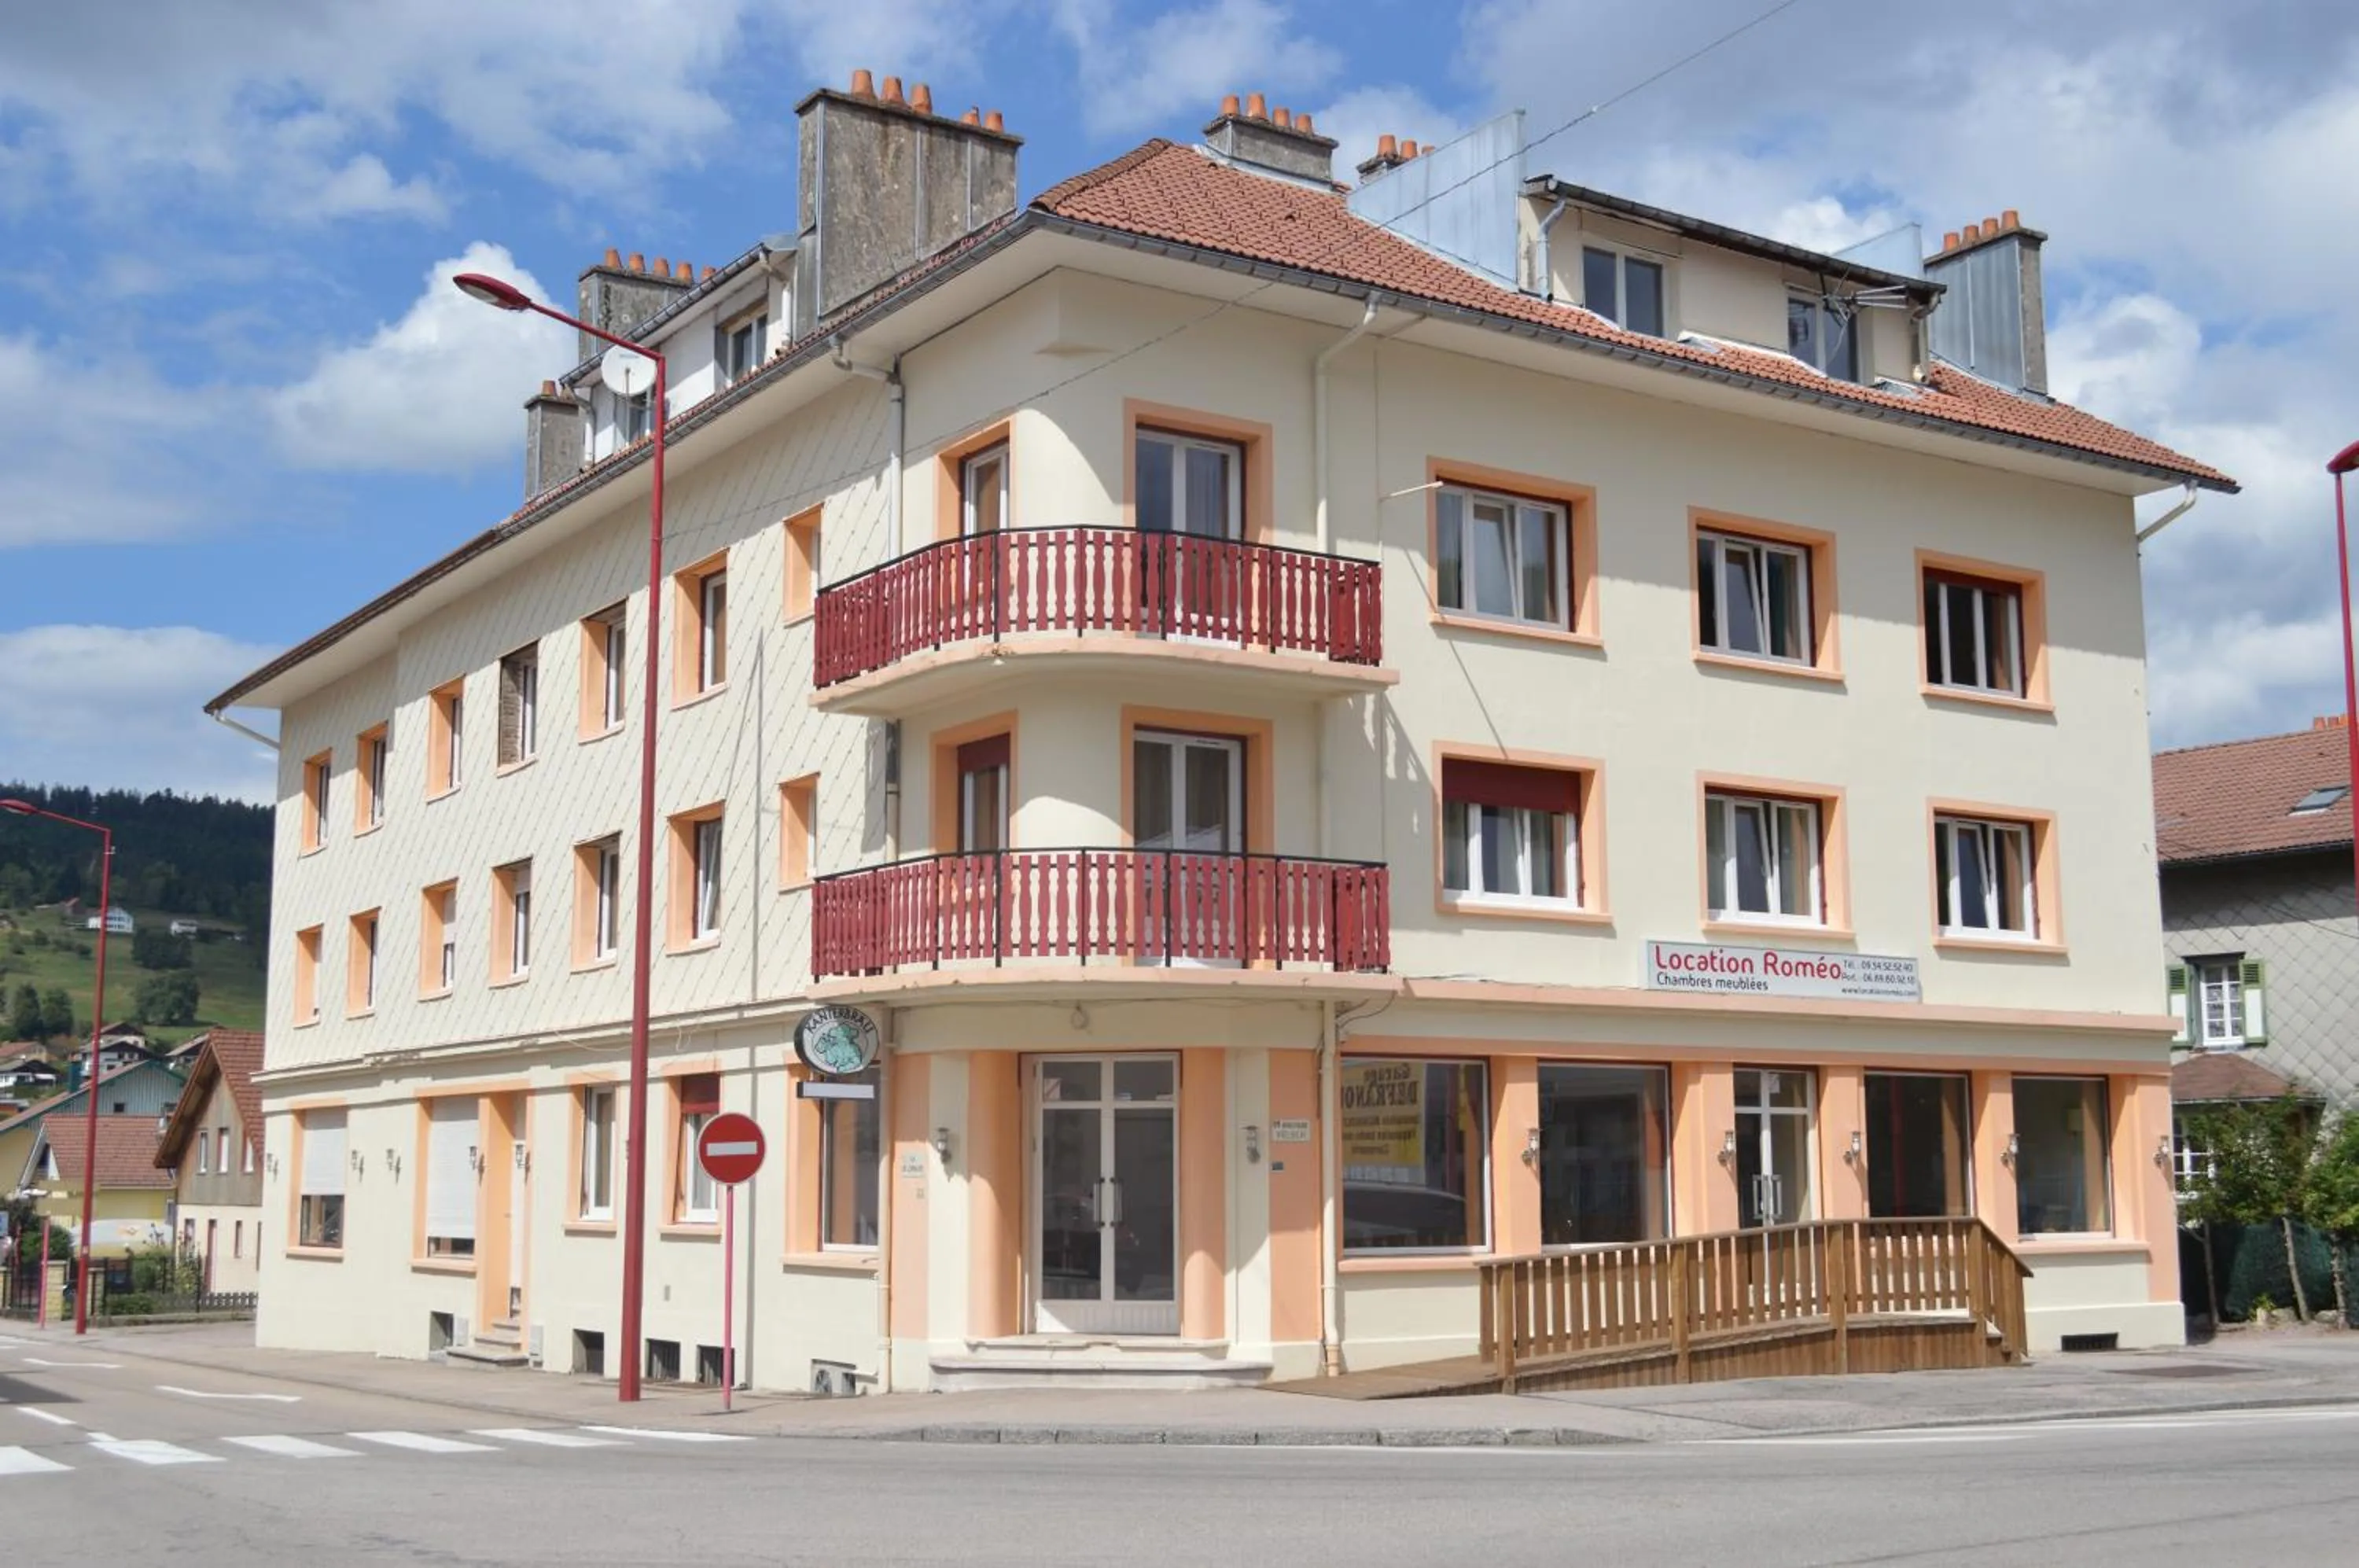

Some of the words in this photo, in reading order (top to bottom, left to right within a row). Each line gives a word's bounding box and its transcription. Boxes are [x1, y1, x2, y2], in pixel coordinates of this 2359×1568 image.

[1655, 944, 1754, 974] Location
[1764, 951, 1841, 980] Roméo
[1657, 971, 1712, 988] Chambres
[1715, 977, 1768, 991] meublées
